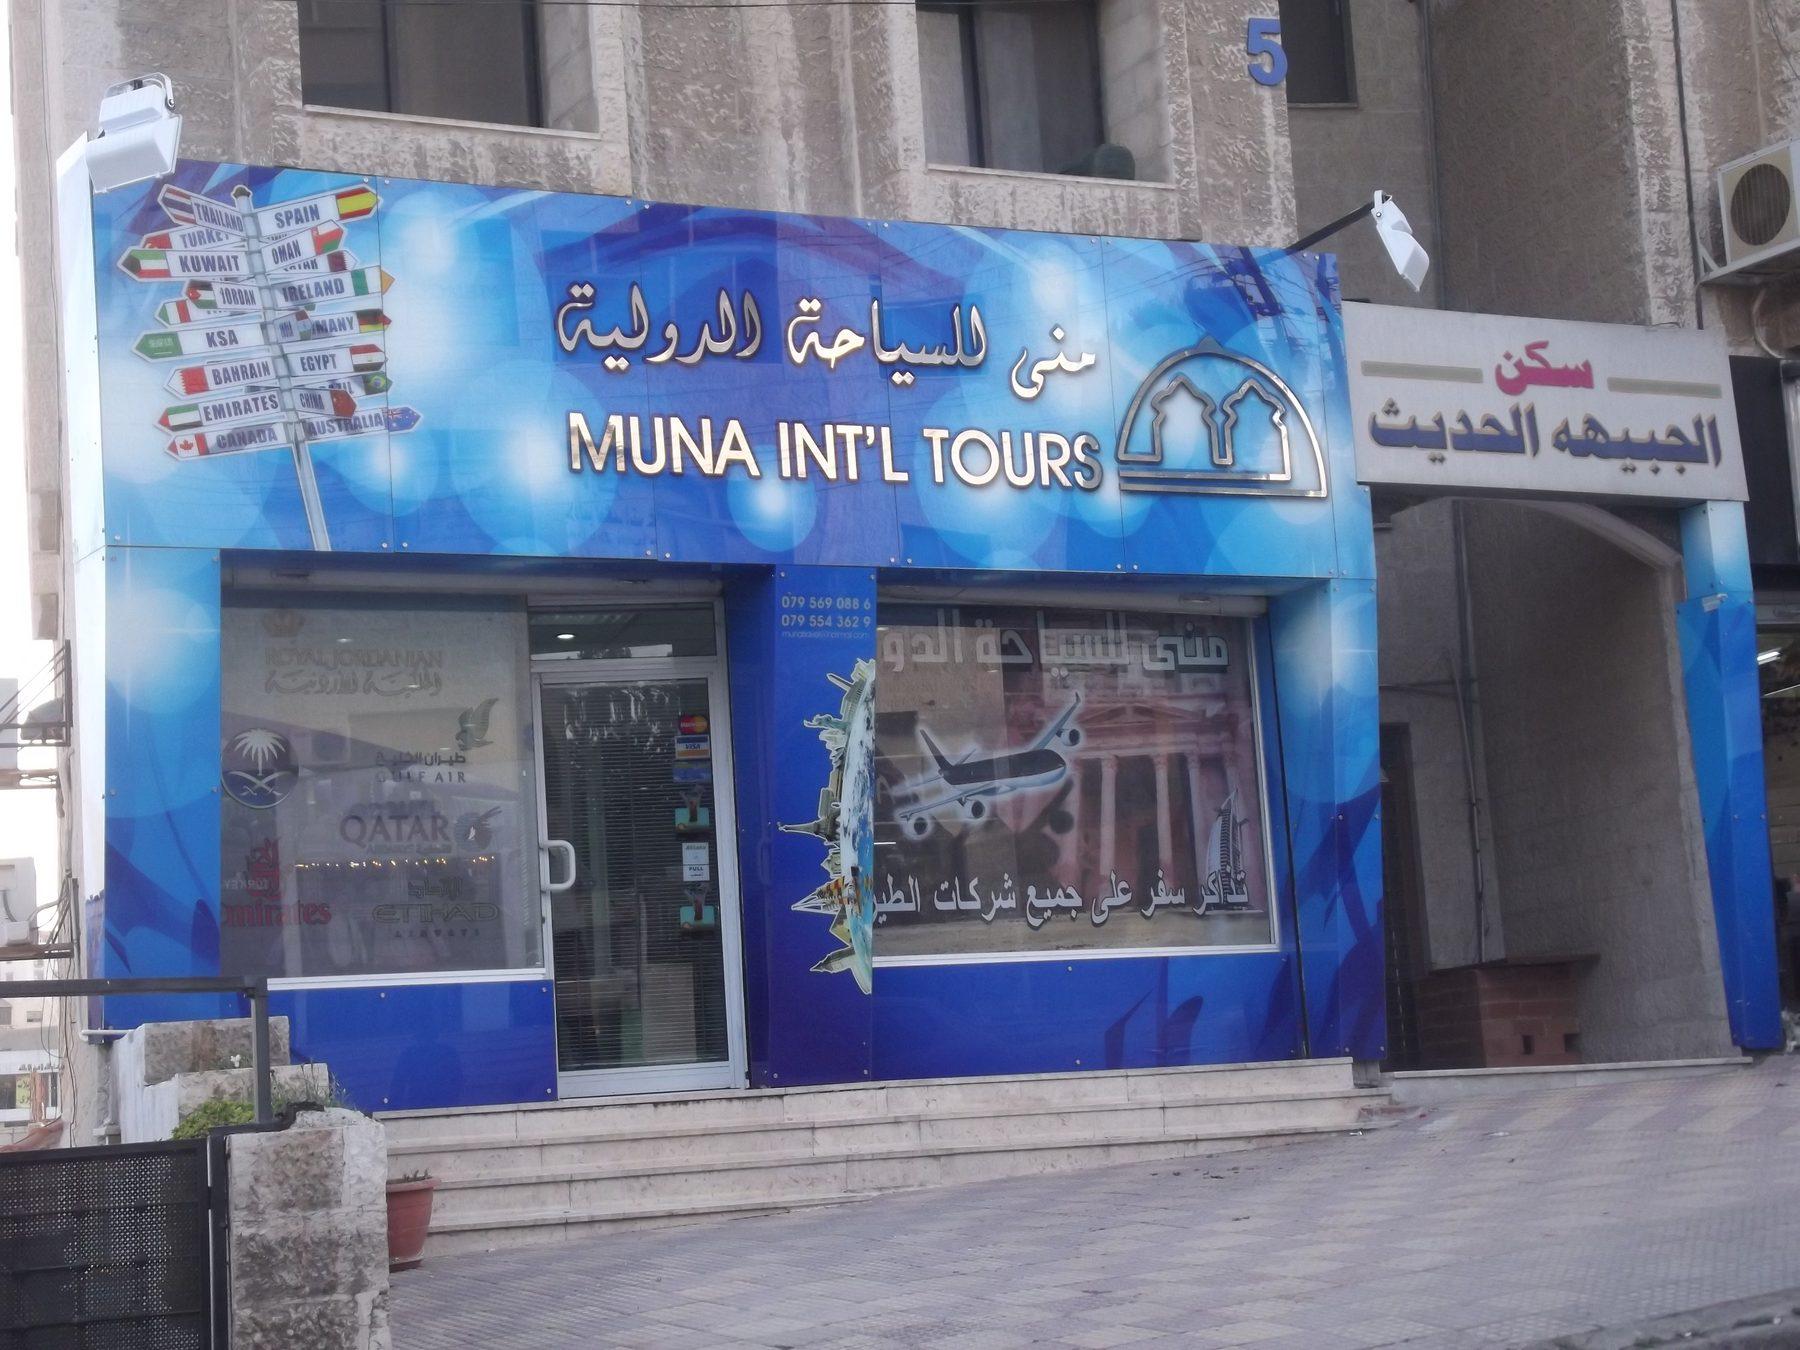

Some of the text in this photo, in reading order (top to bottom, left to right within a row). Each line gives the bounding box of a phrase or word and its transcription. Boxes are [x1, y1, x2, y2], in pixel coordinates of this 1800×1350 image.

[1247, 18, 1288, 86] 5
[194, 202, 244, 233] THAILAND
[274, 203, 320, 229] SPAIN
[179, 254, 240, 273] KUWAIT
[271, 239, 302, 265] OMAN
[220, 287, 257, 306] JORDAN
[282, 278, 345, 303] IRELAND
[205, 330, 239, 348] KSA
[557, 281, 1096, 399] منى للسياحة الدولية
[212, 361, 271, 385] BAHRAIN
[300, 353, 337, 372] EGYPT
[1494, 340, 1595, 396] سكن
[203, 394, 279, 422] EMIRATES
[299, 393, 325, 410] CHINA
[216, 427, 278, 449] CANADA
[309, 413, 386, 436] AUSTRALIA
[1369, 398, 1722, 475] الجبيهه الحديث
[568, 411, 1104, 490] MUNA INT'L TOURS
[781, 596, 805, 609] 079
[809, 597, 833, 610] 569
[781, 614, 805, 627] 079
[809, 615, 833, 628] 554
[975, 609, 1130, 680] للسياحة
[1142, 620, 1230, 672] منى
[434, 771, 466, 784] AIR
[340, 814, 451, 850] QATAR
[934, 872, 1017, 922] شركات
[1090, 869, 1133, 926] على
[1140, 868, 1186, 919] سفر
[1192, 863, 1250, 917] تذاكر
[372, 901, 501, 924] ETIHAD
[1025, 884, 1084, 928] جميع
